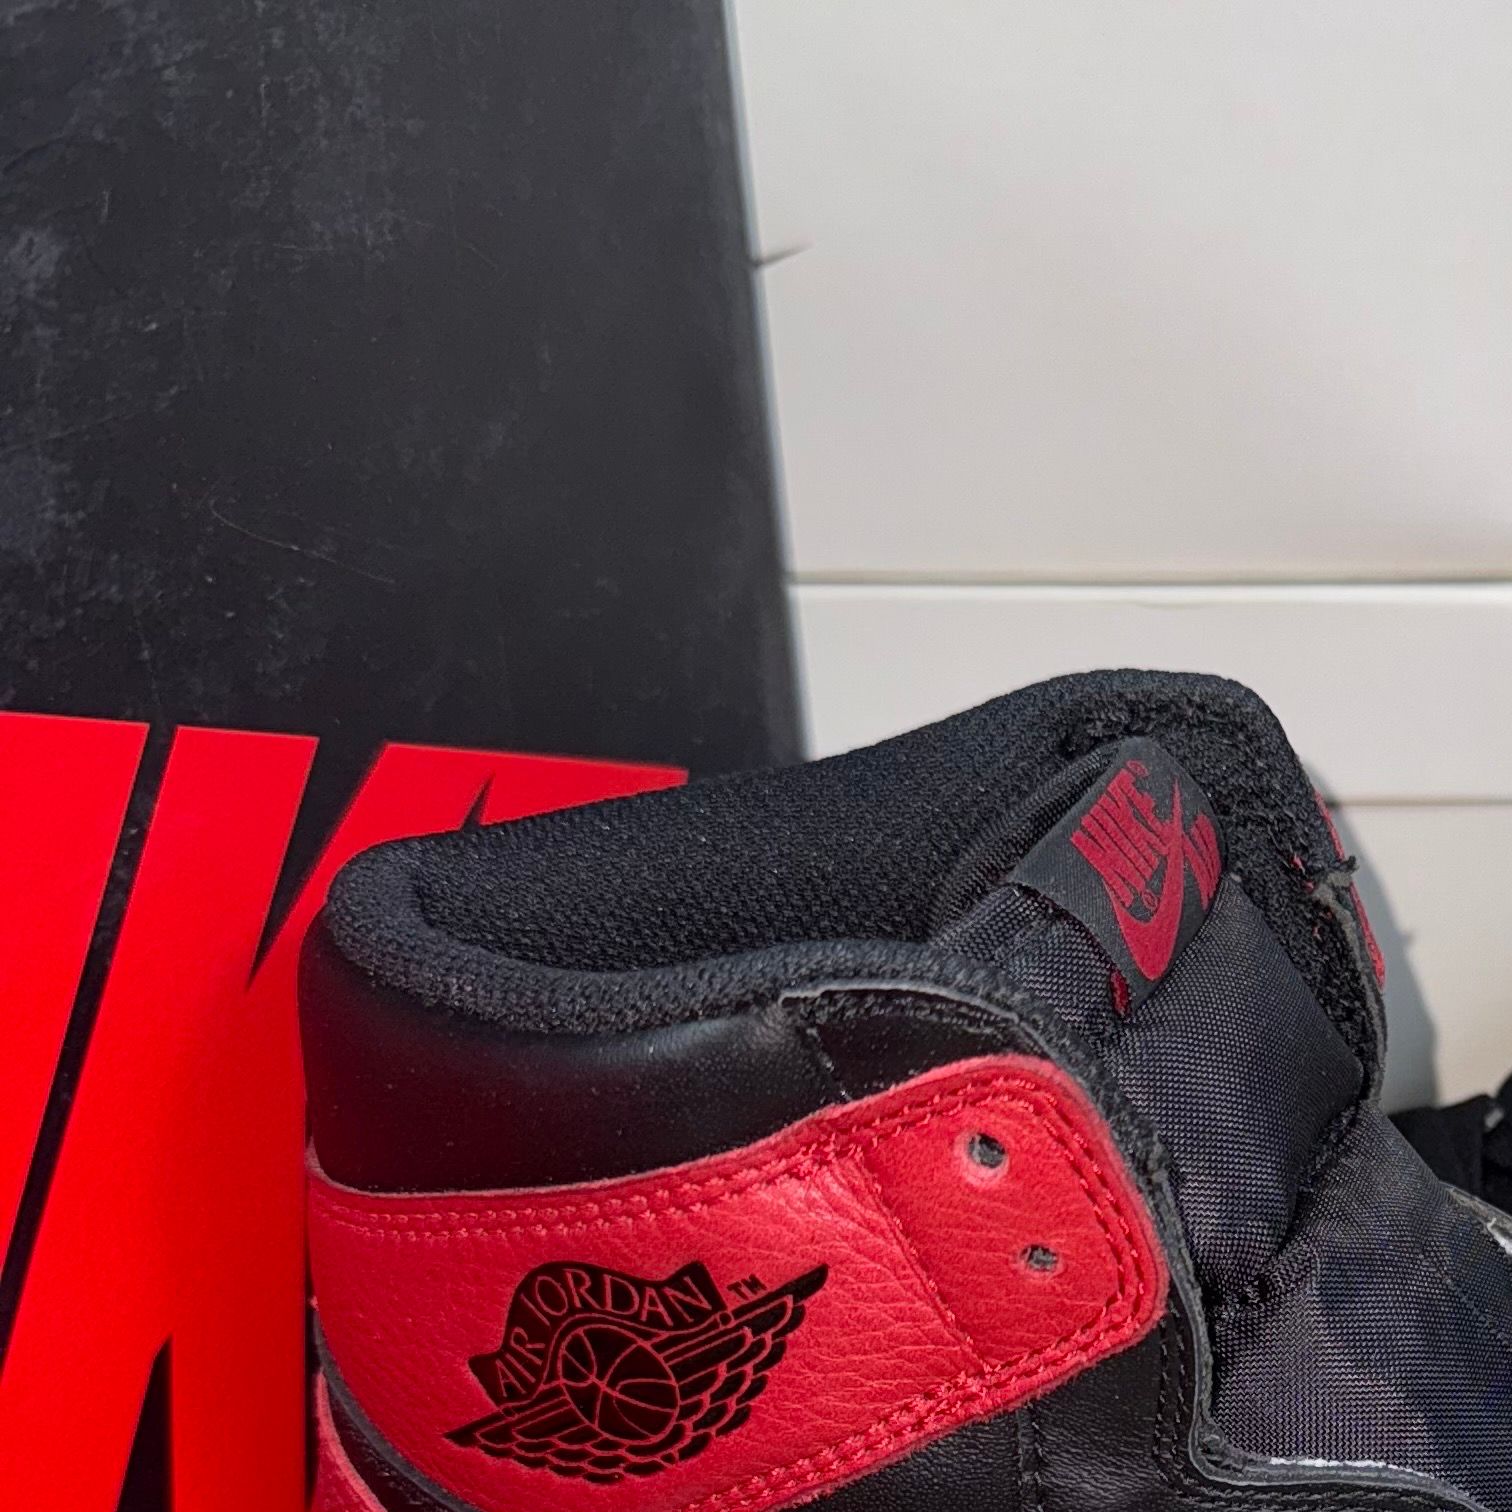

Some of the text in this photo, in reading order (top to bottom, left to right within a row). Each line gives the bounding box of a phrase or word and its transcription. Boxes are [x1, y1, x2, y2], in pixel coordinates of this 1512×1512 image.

[1070, 767, 1168, 908] NIKE
[520, 1268, 713, 1326] JORDAN
[496, 1326, 546, 1398] AIR
